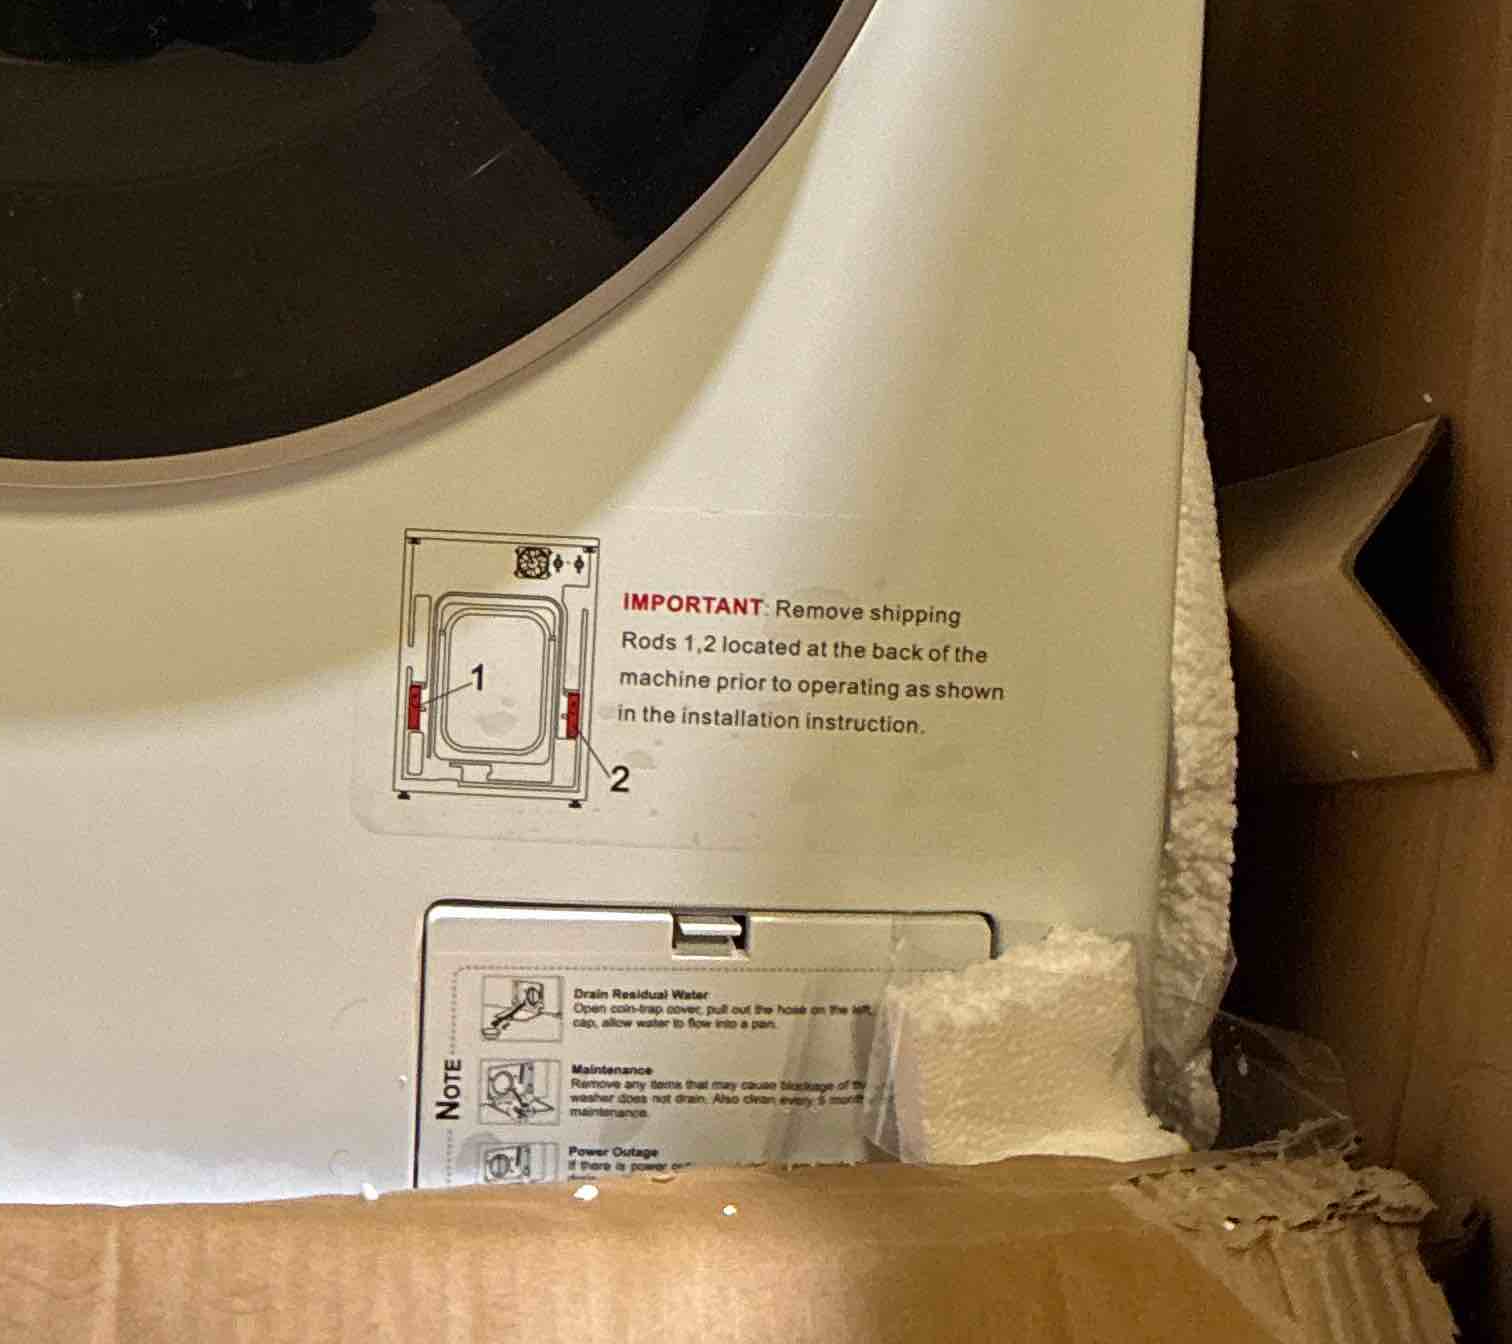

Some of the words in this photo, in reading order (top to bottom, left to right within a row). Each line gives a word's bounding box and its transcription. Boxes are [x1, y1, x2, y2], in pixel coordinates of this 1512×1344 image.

[775, 600, 865, 620] Remove
[869, 604, 962, 628] shipping
[621, 631, 677, 651] Rods
[685, 634, 717, 655] 1,2
[722, 635, 801, 657] located
[806, 641, 827, 658] at
[833, 640, 866, 659] the
[871, 642, 924, 661] back
[928, 644, 951, 663] of
[955, 645, 988, 664] the
[470, 664, 486, 691] 1
[619, 669, 711, 689] machine
[716, 672, 767, 693] prior
[772, 674, 793, 693] to
[798, 677, 900, 701] operating
[904, 682, 932, 698] as
[935, 681, 1005, 701] shown
[617, 703, 636, 722] in
[642, 704, 676, 724] the
[681, 705, 800, 730] installation
[805, 711, 926, 736] instruction.
[609, 767, 631, 793] 2
[573, 988, 609, 1000] Drain
[612, 988, 668, 1000] Residual
[672, 989, 710, 1000] Water
[573, 1001, 607, 1014] Open
[601, 1018, 633, 1029] allow
[637, 1018, 670, 1029] water
[571, 1063, 654, 1076] Maintenance
[571, 1078, 622, 1089] Remove
[624, 1080, 646, 1091] any
[570, 1093, 615, 1104] washer
[617, 1093, 648, 1105] does
[652, 1094, 672, 1105] not
[712, 1093, 740, 1105] Also
[568, 1145, 609, 1157] Power
[612, 1146, 660, 1160] Outage
[580, 1160, 611, 1171] there
